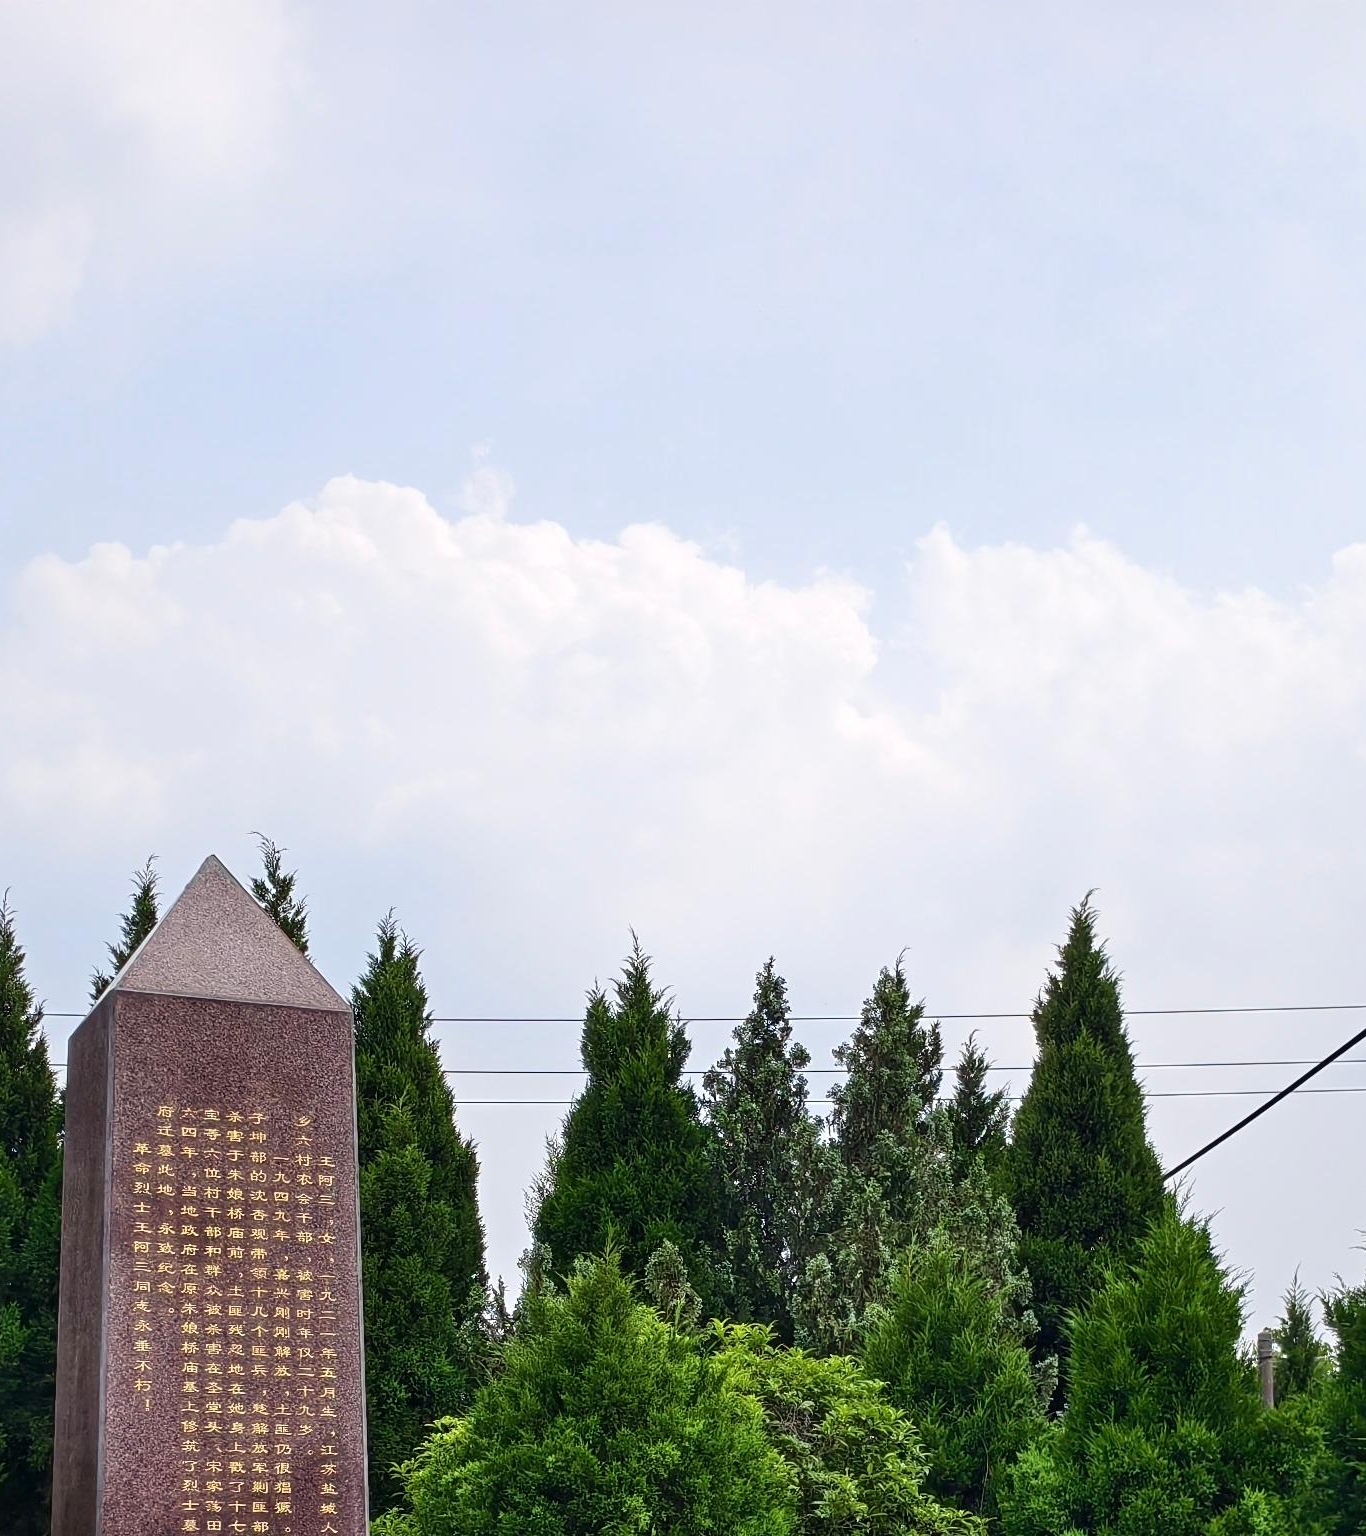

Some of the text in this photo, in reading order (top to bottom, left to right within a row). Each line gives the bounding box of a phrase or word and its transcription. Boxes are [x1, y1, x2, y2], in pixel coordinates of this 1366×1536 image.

[132, 1142, 153, 1412] 革命烈士王阿三同志永垂不朽！
